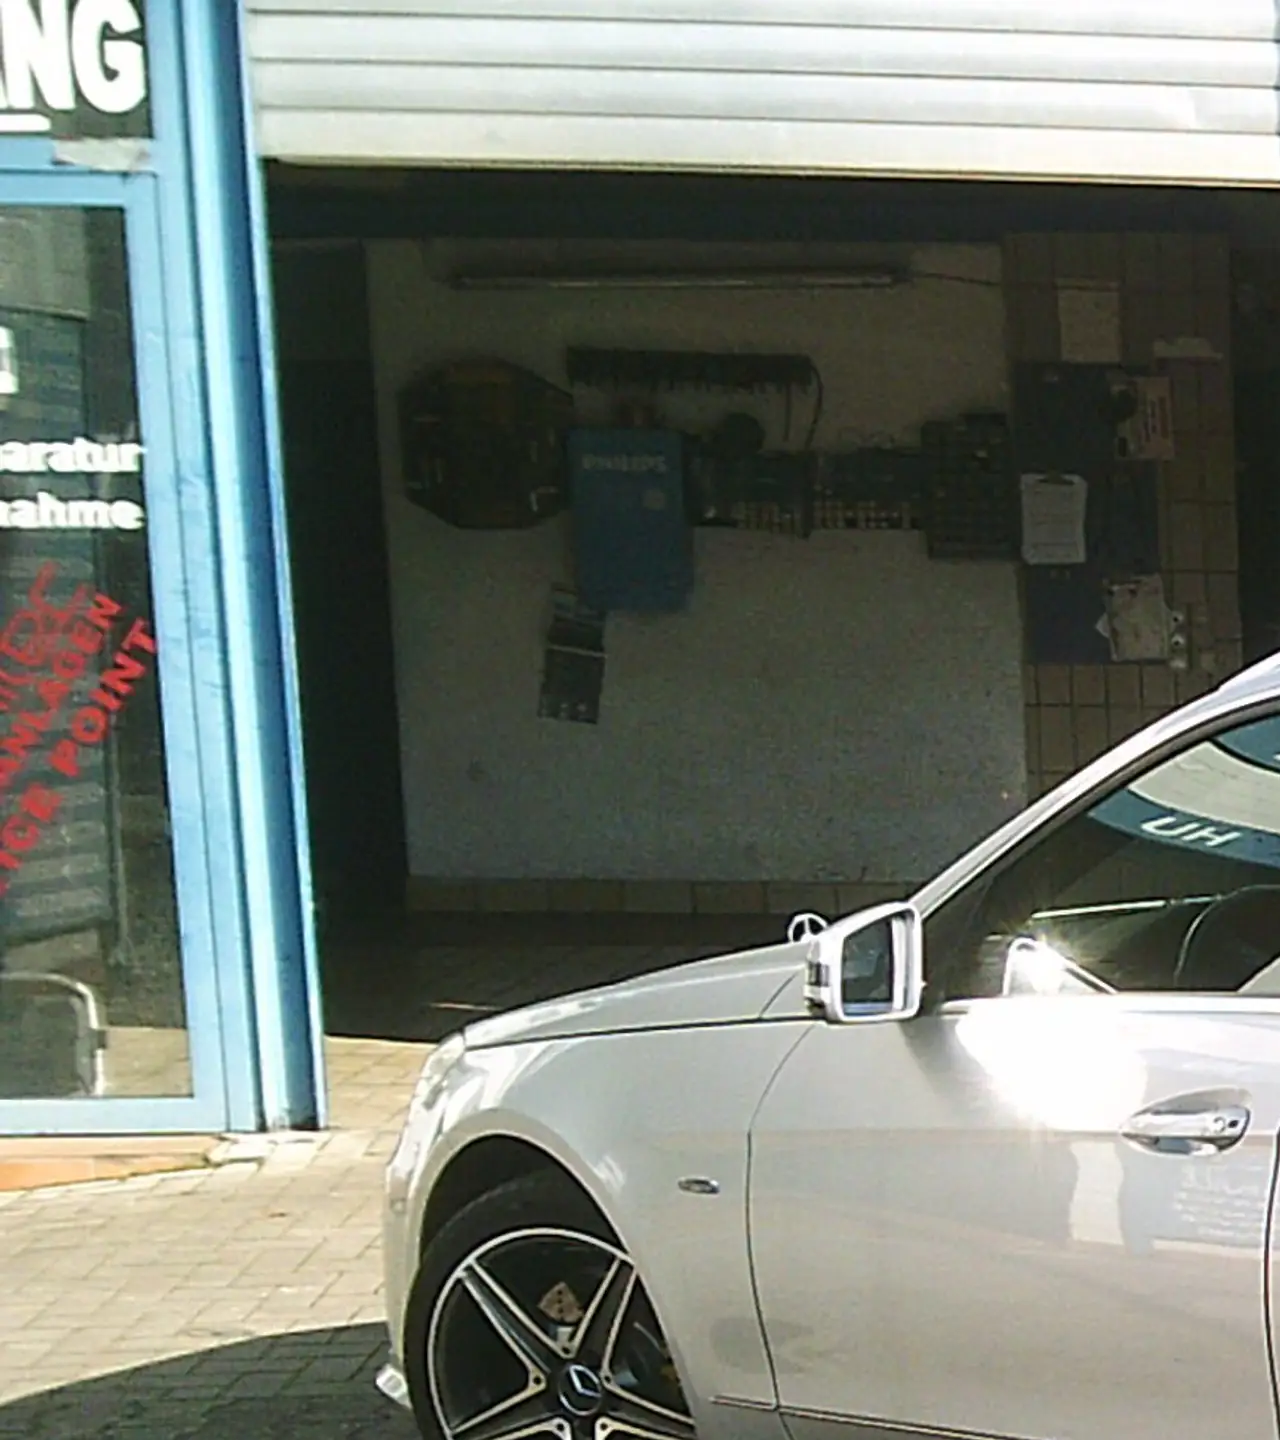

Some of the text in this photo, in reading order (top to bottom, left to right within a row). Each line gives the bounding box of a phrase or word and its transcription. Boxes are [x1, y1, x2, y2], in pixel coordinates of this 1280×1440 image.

[0, 0, 147, 114] NG
[0, 437, 146, 472] aratur
[51, 617, 156, 777] POINT
